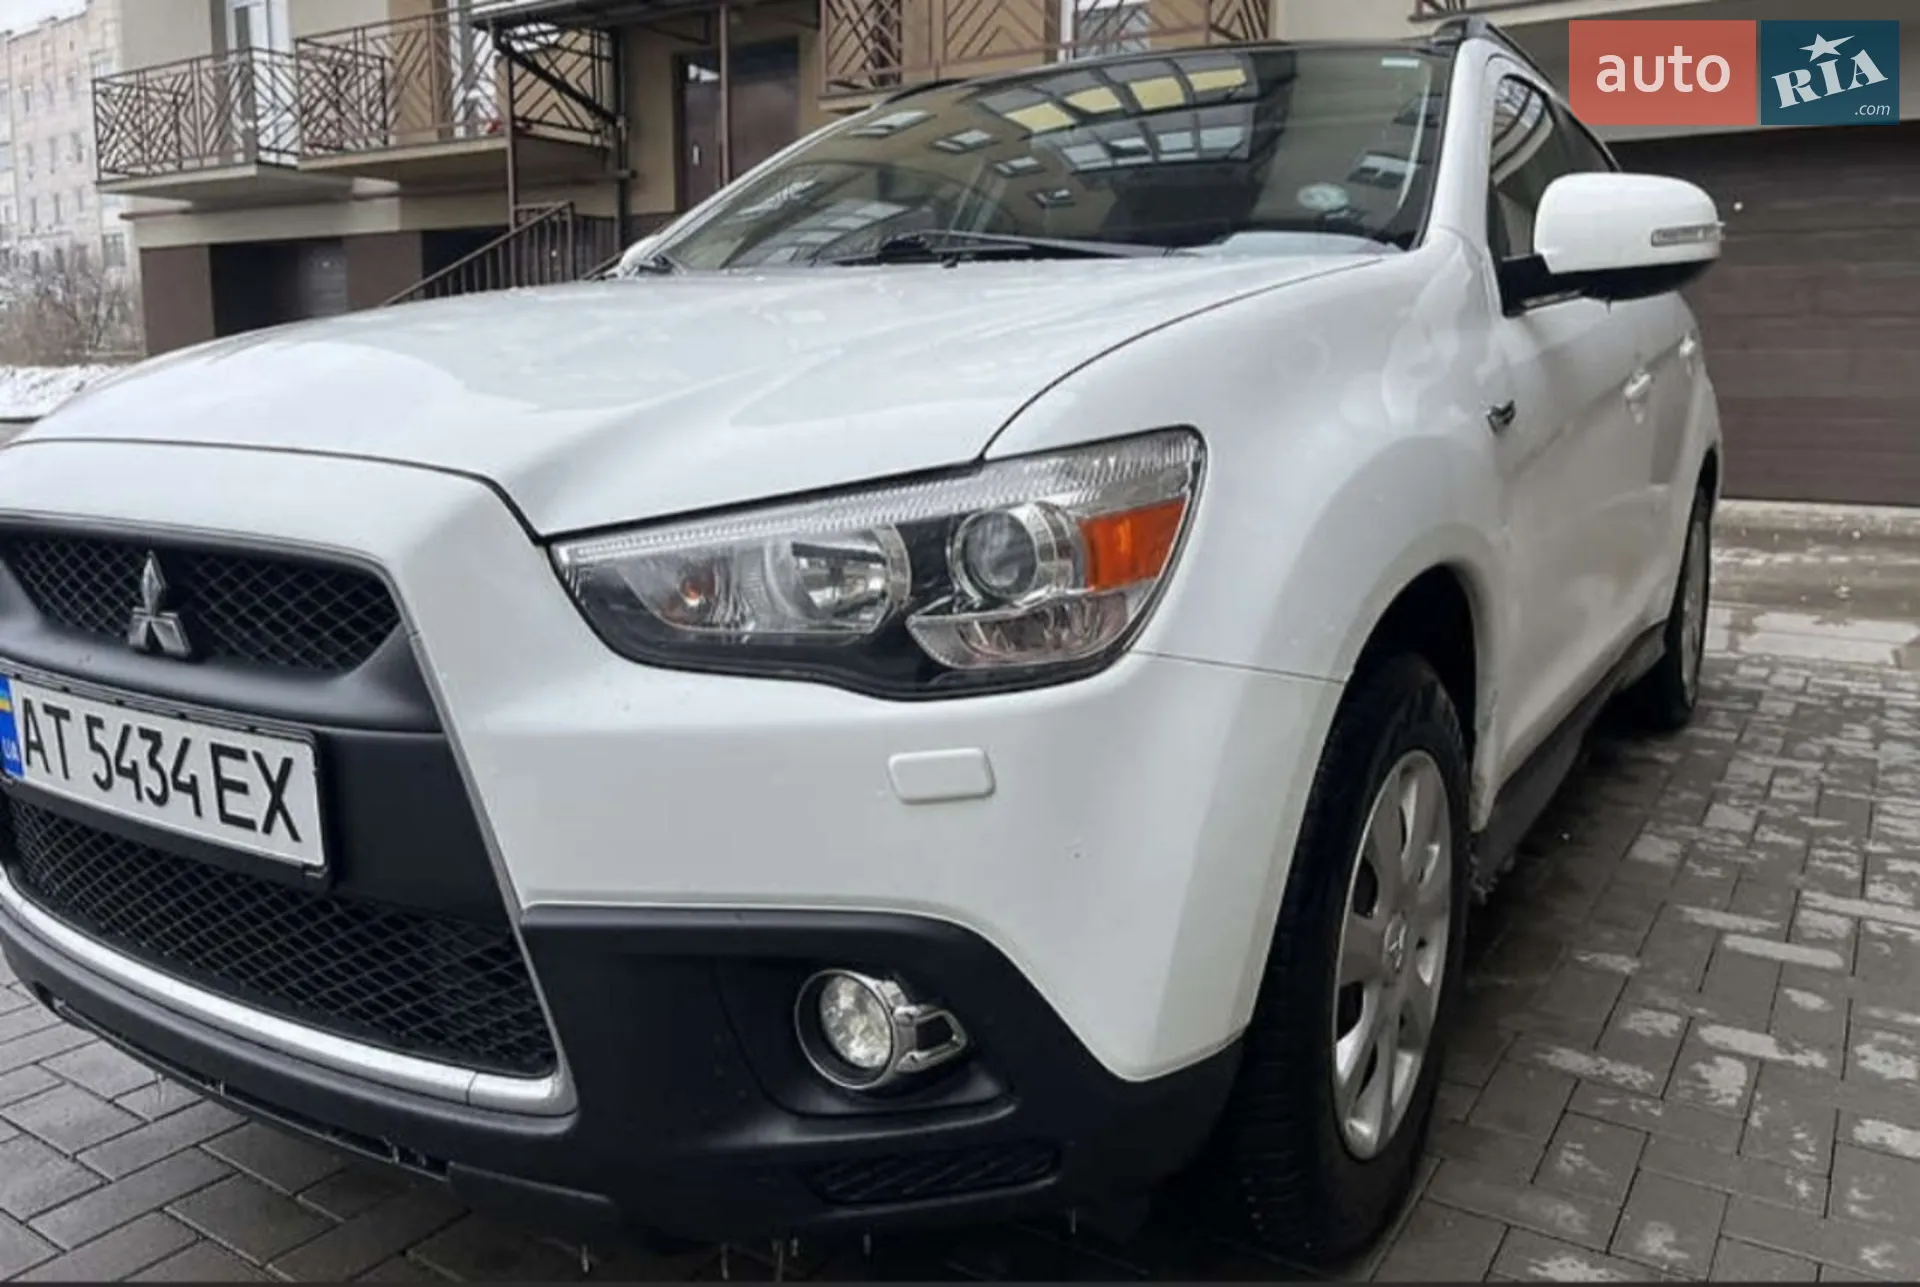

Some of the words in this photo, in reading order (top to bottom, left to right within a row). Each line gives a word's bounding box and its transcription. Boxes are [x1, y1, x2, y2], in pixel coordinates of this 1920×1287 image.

[22, 698, 70, 780] AT
[85, 714, 202, 818] 5434
[210, 742, 302, 843] EX
